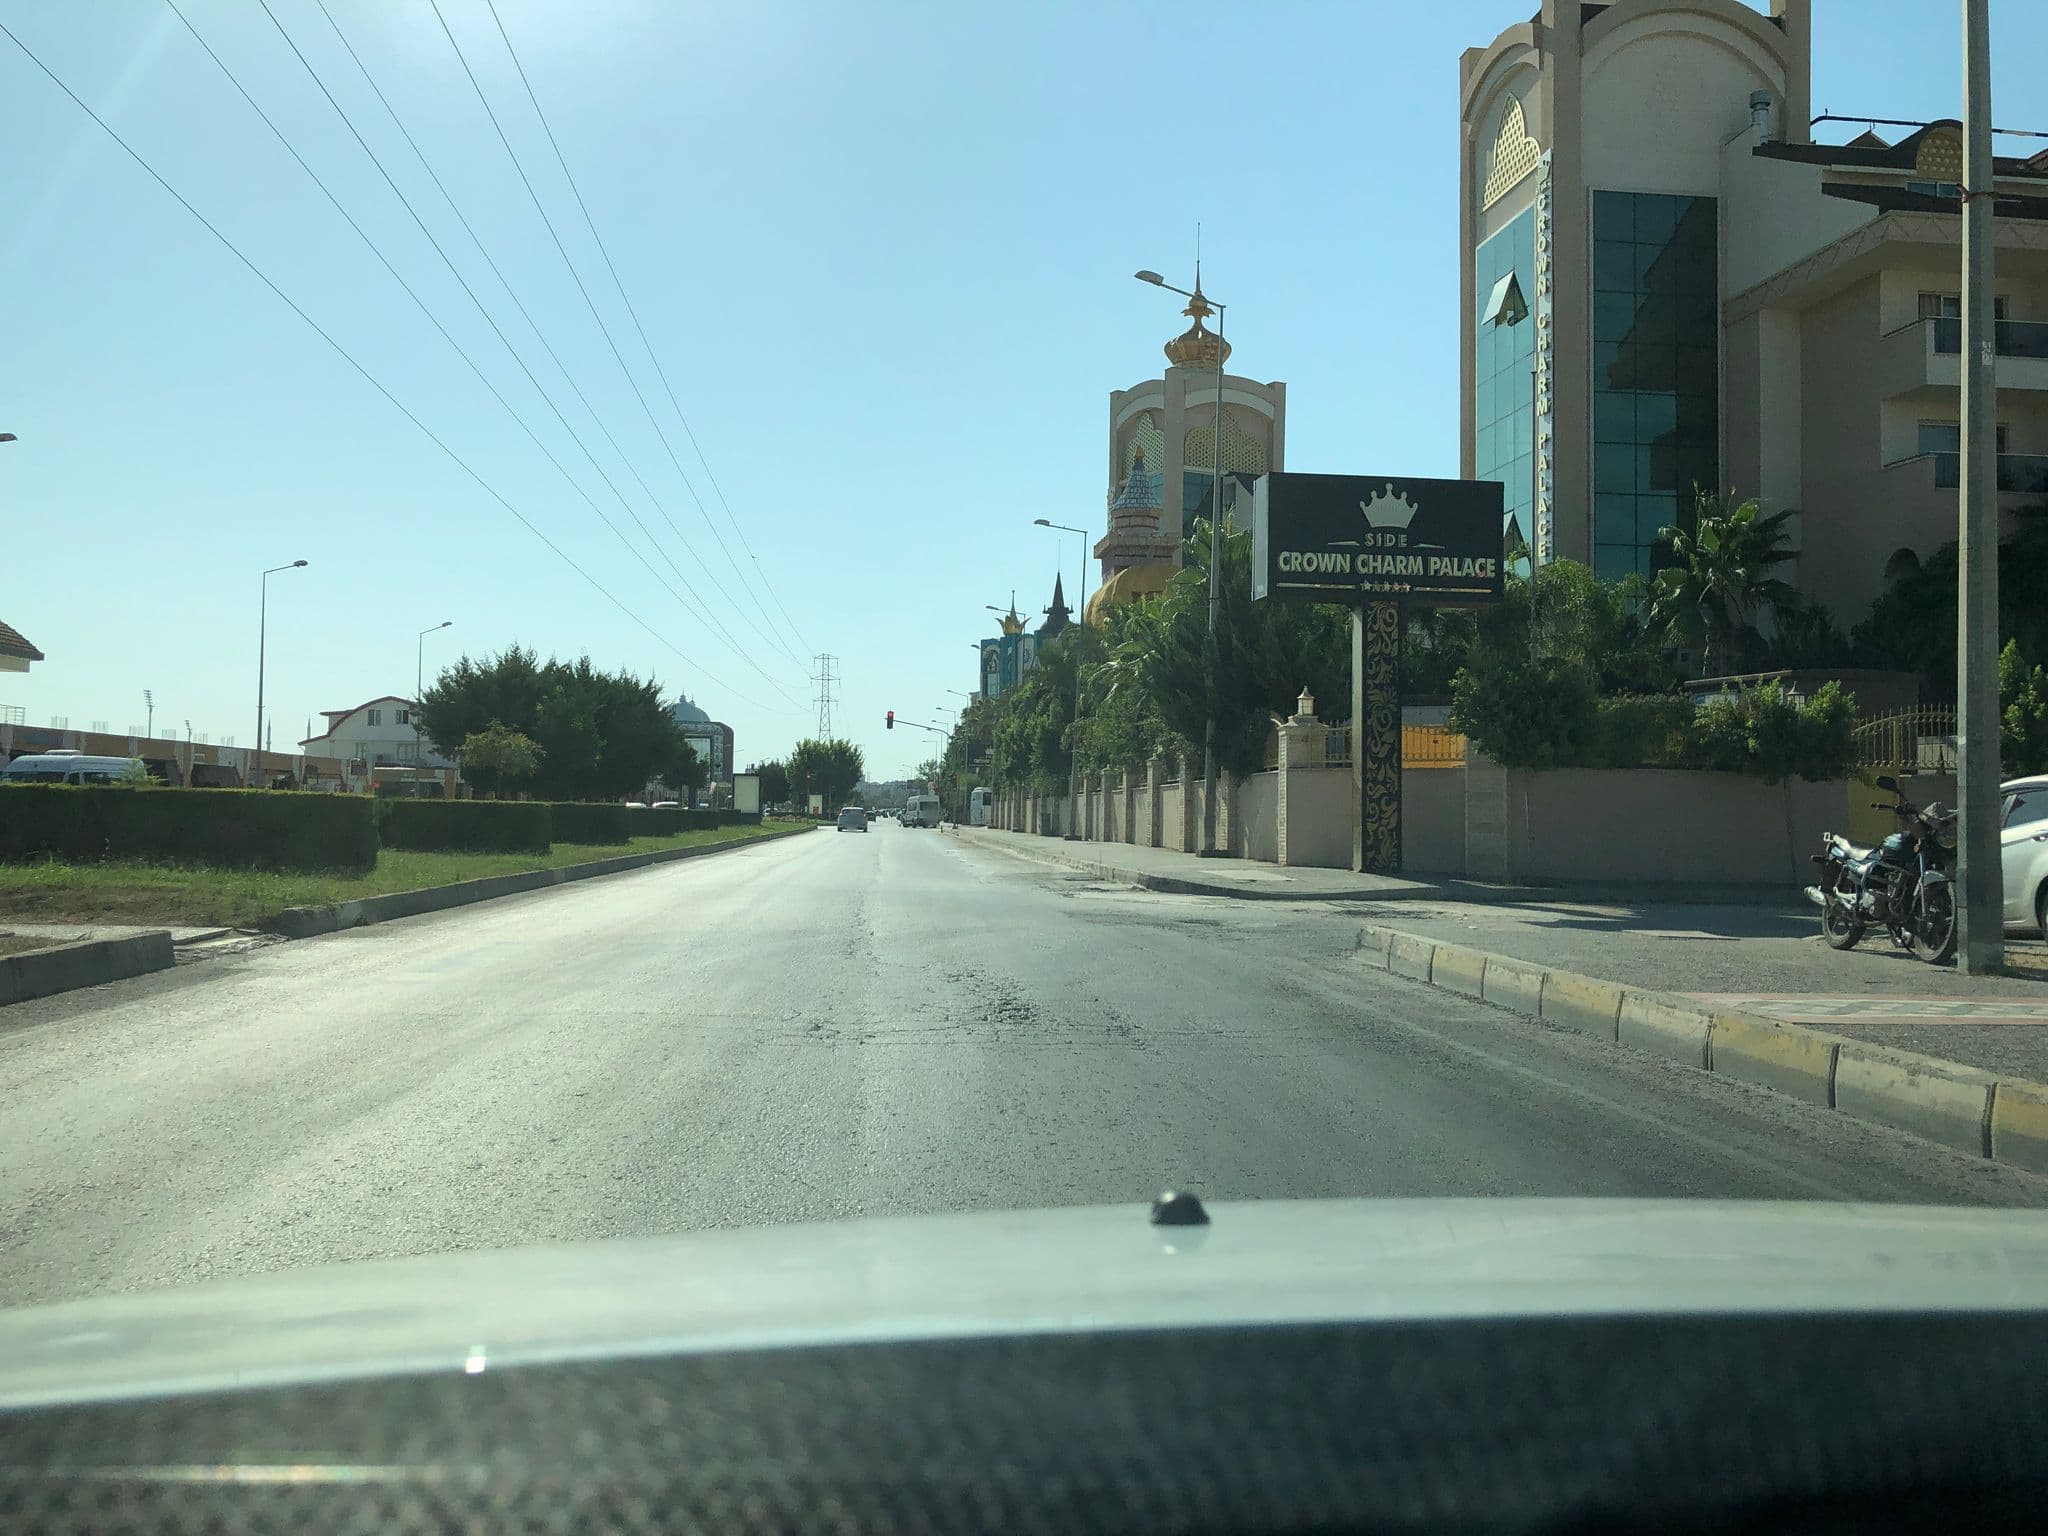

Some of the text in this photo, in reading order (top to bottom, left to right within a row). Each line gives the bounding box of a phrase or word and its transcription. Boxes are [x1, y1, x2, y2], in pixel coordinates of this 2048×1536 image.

[1537, 193, 1547, 297] CROWN
[1537, 313, 1548, 417] CHARM
[1364, 533, 1408, 548] SIDE
[1537, 433, 1548, 558] PALACE
[1278, 551, 1496, 578] CROWN CHARM PALACE
